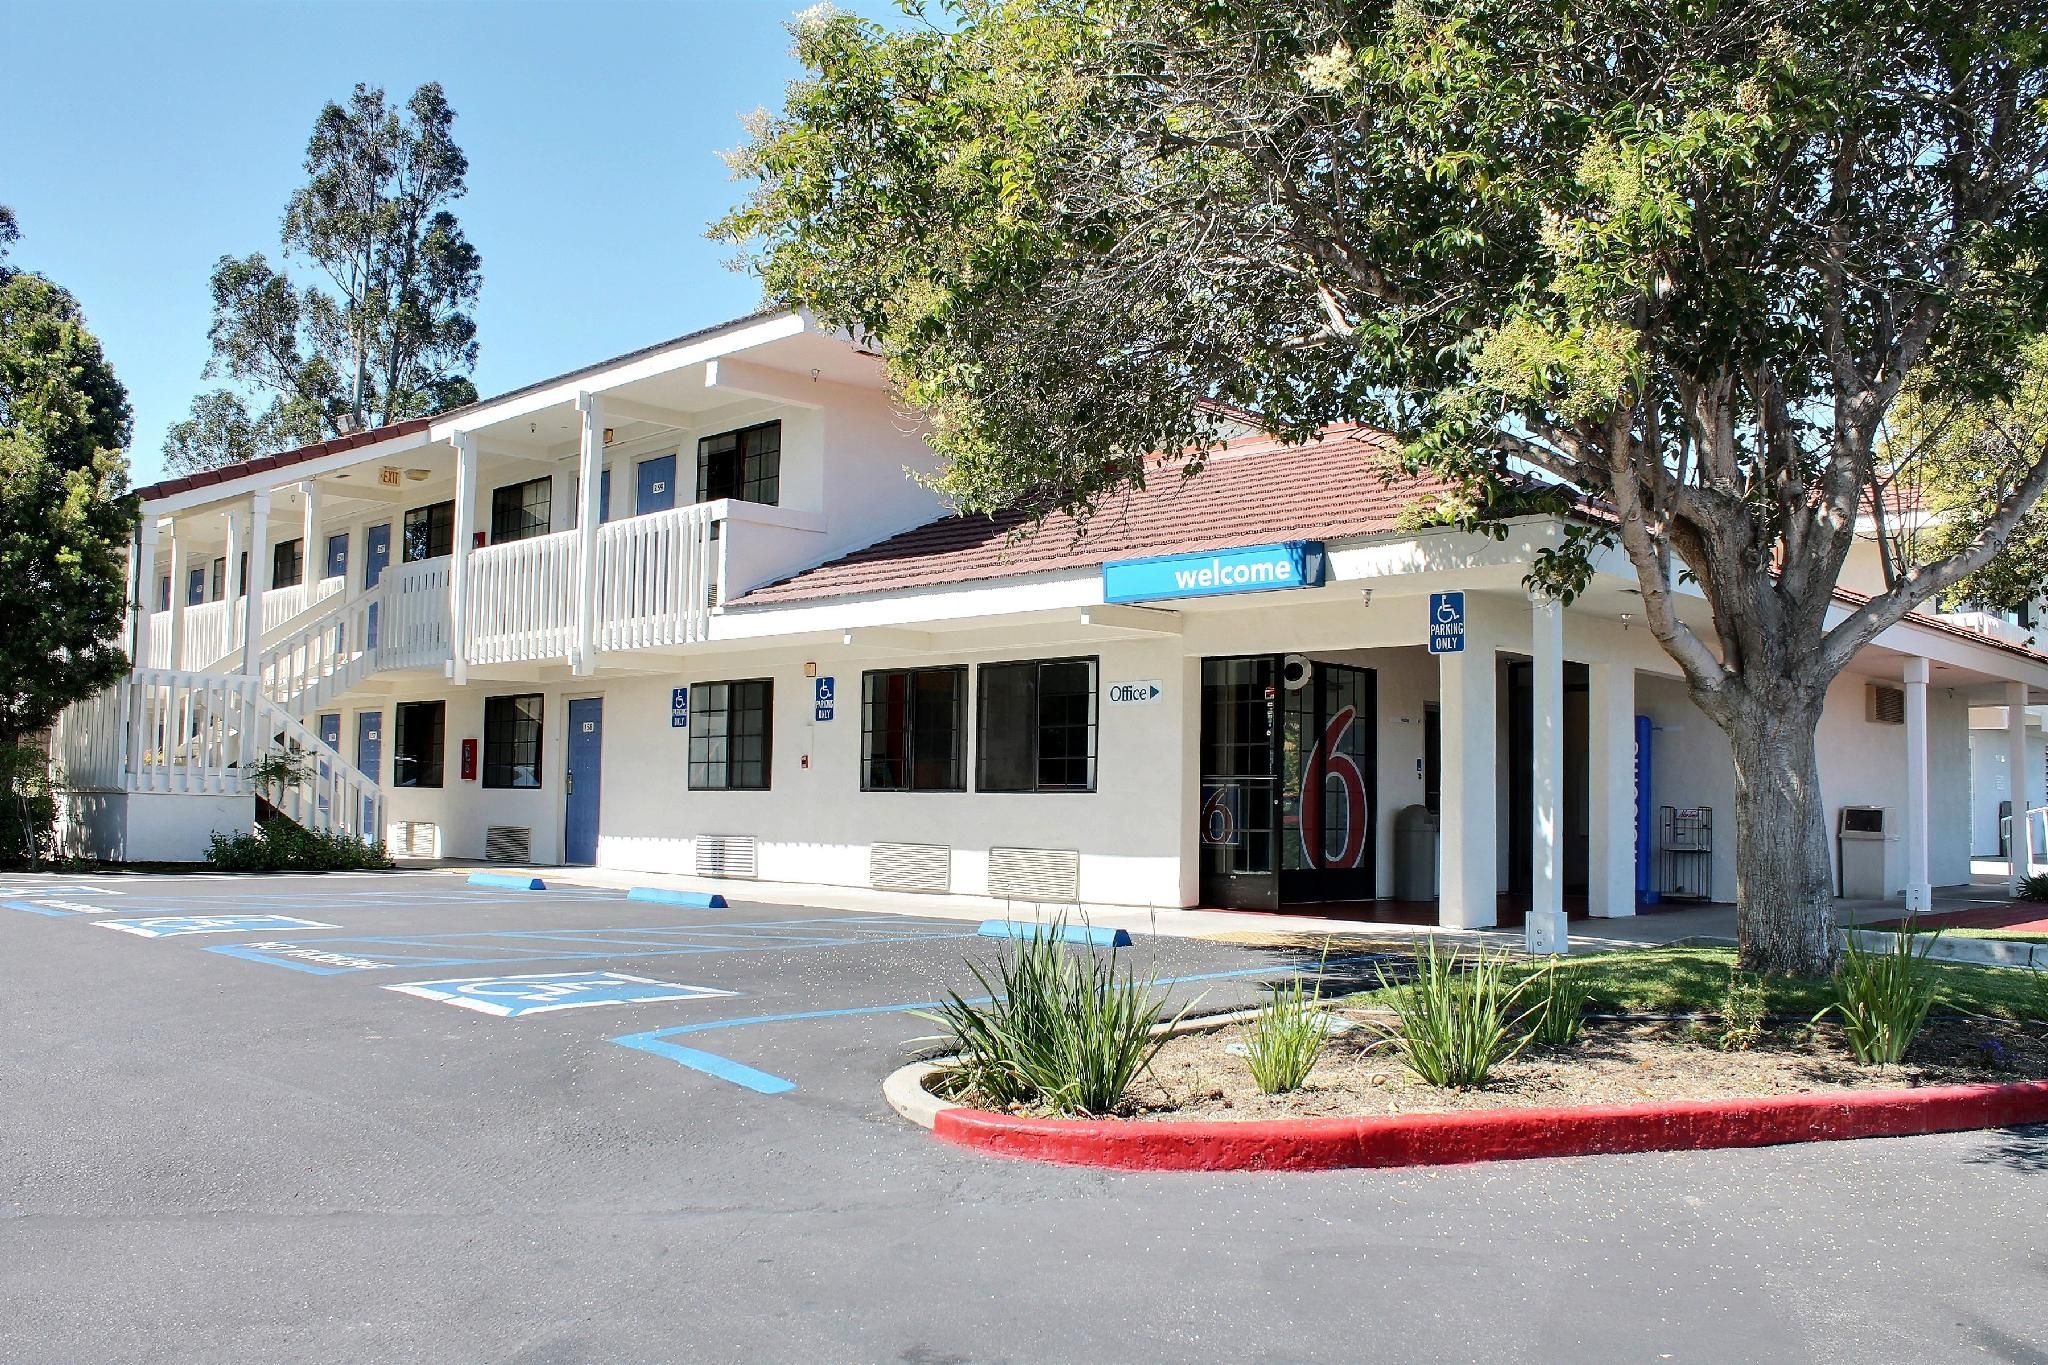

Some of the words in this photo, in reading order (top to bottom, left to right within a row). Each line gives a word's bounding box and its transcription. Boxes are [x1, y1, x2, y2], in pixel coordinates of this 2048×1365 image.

[384, 470, 399, 484] EXIT
[1174, 559, 1291, 589] welcome
[1430, 622, 1464, 636] PARKING
[1436, 637, 1458, 650] ONLY
[1110, 685, 1147, 702] Office
[816, 700, 834, 708] PARKING
[818, 709, 831, 719] ONLY
[674, 718, 685, 726] ONLY
[1299, 704, 1368, 869] 6
[1201, 786, 1234, 844] 6
